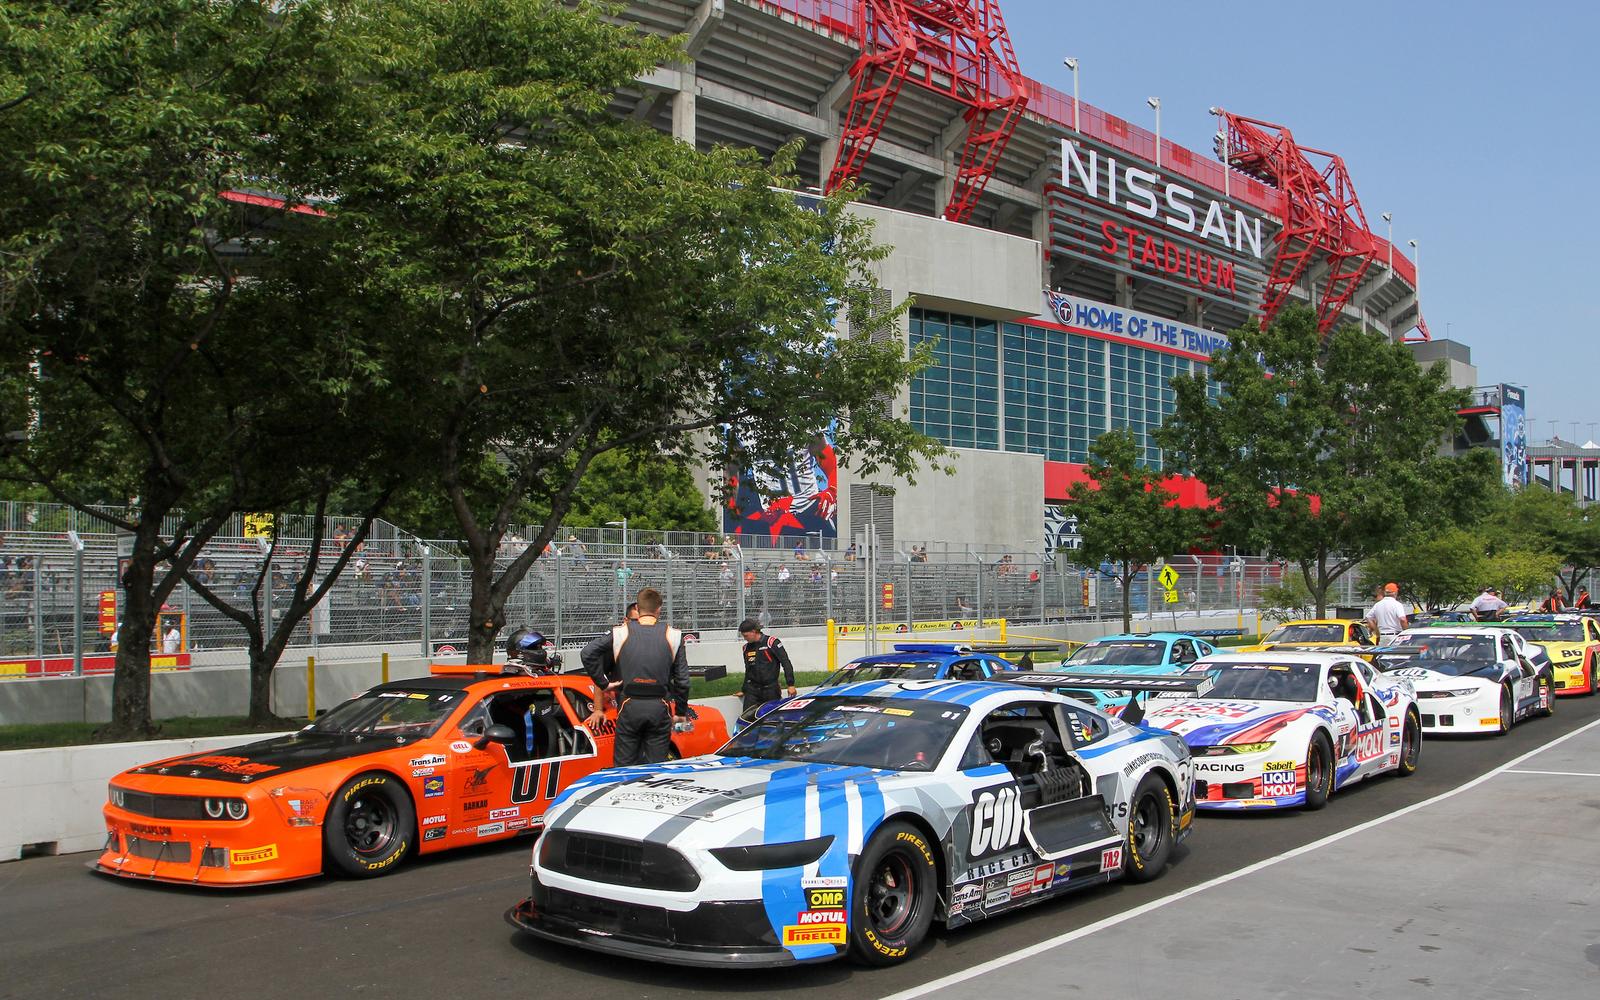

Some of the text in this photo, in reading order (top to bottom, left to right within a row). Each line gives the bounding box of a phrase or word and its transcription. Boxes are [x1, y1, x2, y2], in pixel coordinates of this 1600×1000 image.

[1061, 139, 1261, 258] NISSAN
[1101, 220, 1235, 293] STADIUM
[1076, 304, 1123, 333] HOME
[1128, 316, 1147, 337] OF
[1152, 322, 1177, 345] THE
[1357, 731, 1383, 759] MOLY
[410, 758, 431, 766] Trans
[1265, 761, 1293, 771] Sabelt
[1263, 772, 1294, 784] LIQUI
[344, 777, 386, 801] PIRELLI
[1263, 784, 1295, 796] MOLY
[464, 799, 488, 811] BARKAU
[423, 815, 446, 825] MOTUL
[492, 809, 517, 818] tilton
[232, 848, 274, 862] PIRELLI
[896, 832, 934, 866] PIRELLI
[1103, 850, 1120, 868] TA2
[967, 858, 1005, 880] RACE
[811, 892, 843, 905] OMP
[800, 912, 845, 924] MOTUL
[788, 927, 841, 941] PIRELLI
